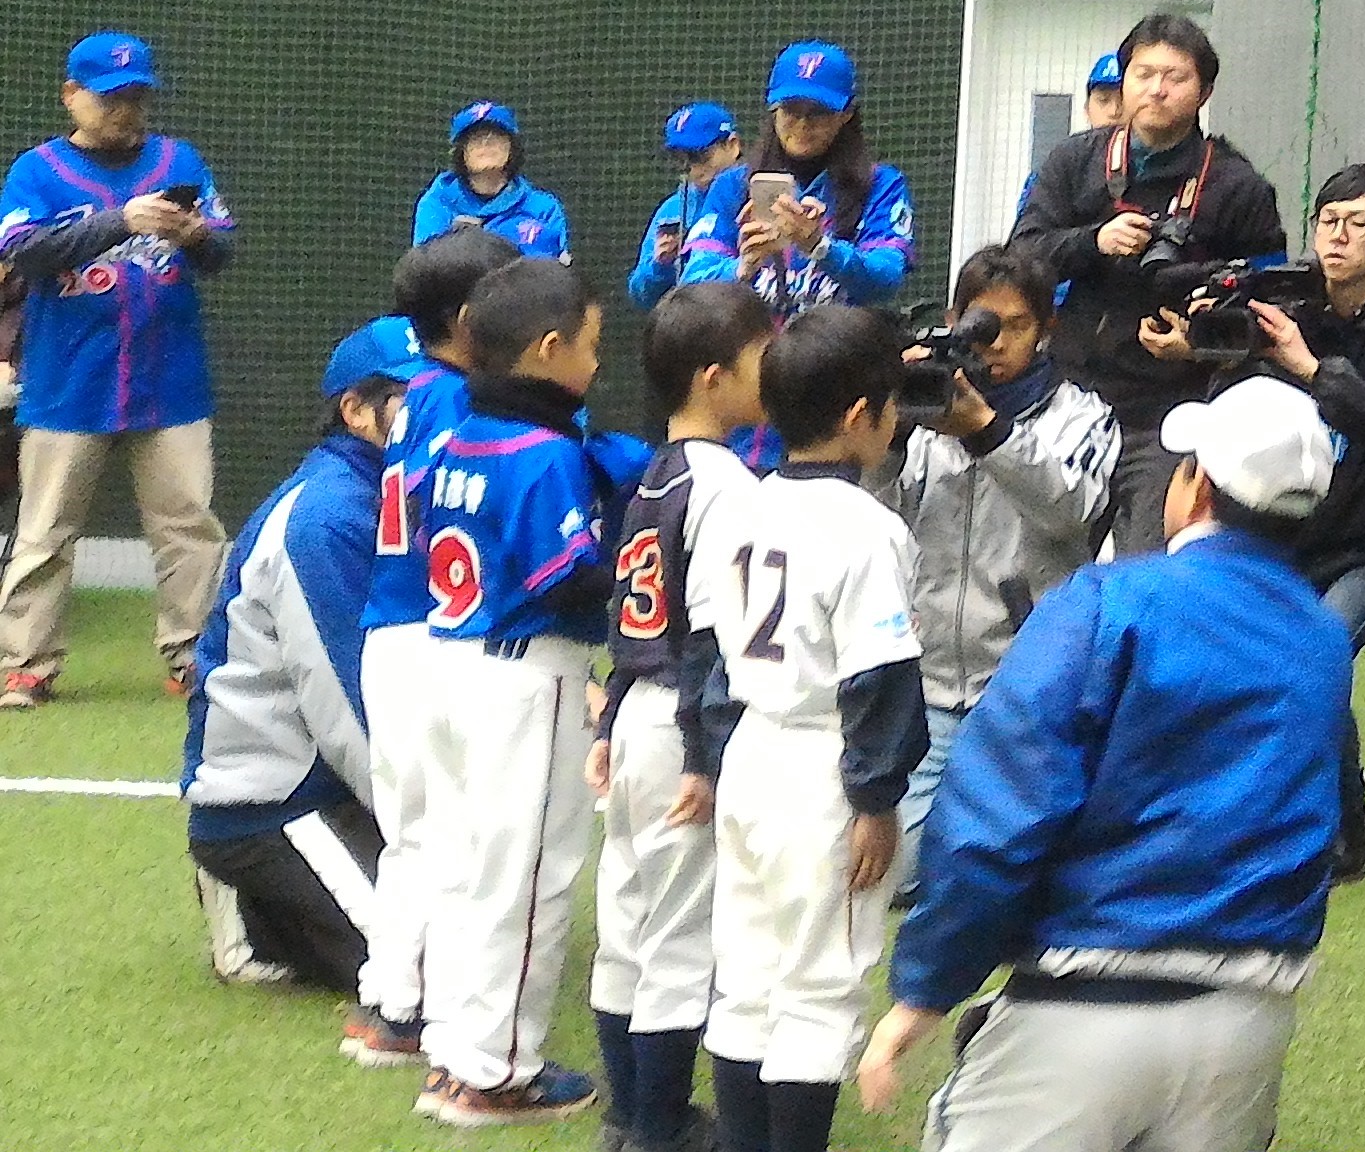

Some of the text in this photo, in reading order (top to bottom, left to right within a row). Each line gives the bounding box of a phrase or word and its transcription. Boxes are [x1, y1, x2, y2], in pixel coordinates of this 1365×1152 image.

[427, 525, 483, 629] 9
[614, 527, 669, 640] 3
[730, 540, 788, 664] 12
